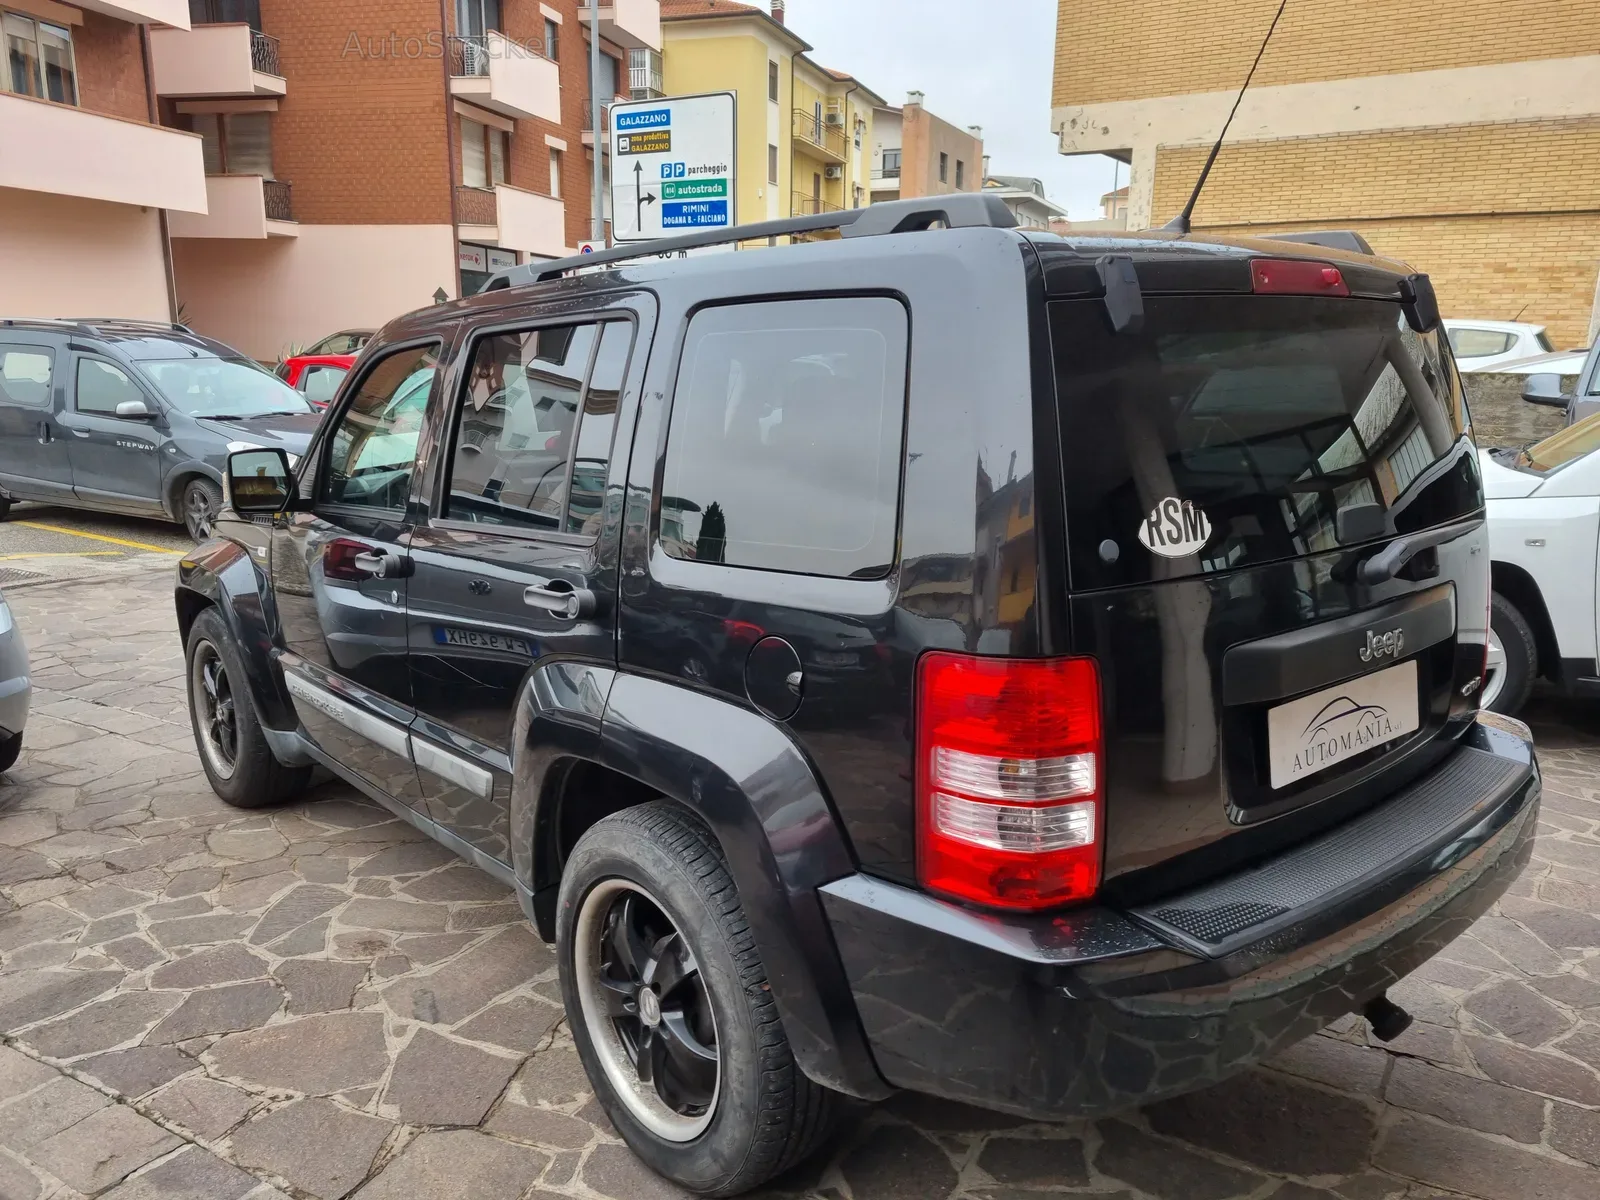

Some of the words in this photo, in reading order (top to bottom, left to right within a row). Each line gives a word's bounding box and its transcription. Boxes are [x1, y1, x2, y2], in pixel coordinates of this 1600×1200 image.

[620, 113, 667, 126] GALAZZANO
[643, 132, 669, 142] produttiva
[631, 142, 669, 152] GALAZZANO
[688, 163, 727, 176] parcheggio
[678, 184, 723, 195] autostrada
[682, 204, 709, 213] RIMINI
[663, 215, 687, 225] DOGANA
[697, 214, 726, 223] FALCIANO
[116, 440, 154, 451] STEPWAY
[1146, 499, 1206, 547] RSM
[1360, 628, 1404, 662] Jeep
[1293, 717, 1393, 773] AUTOMANIA
